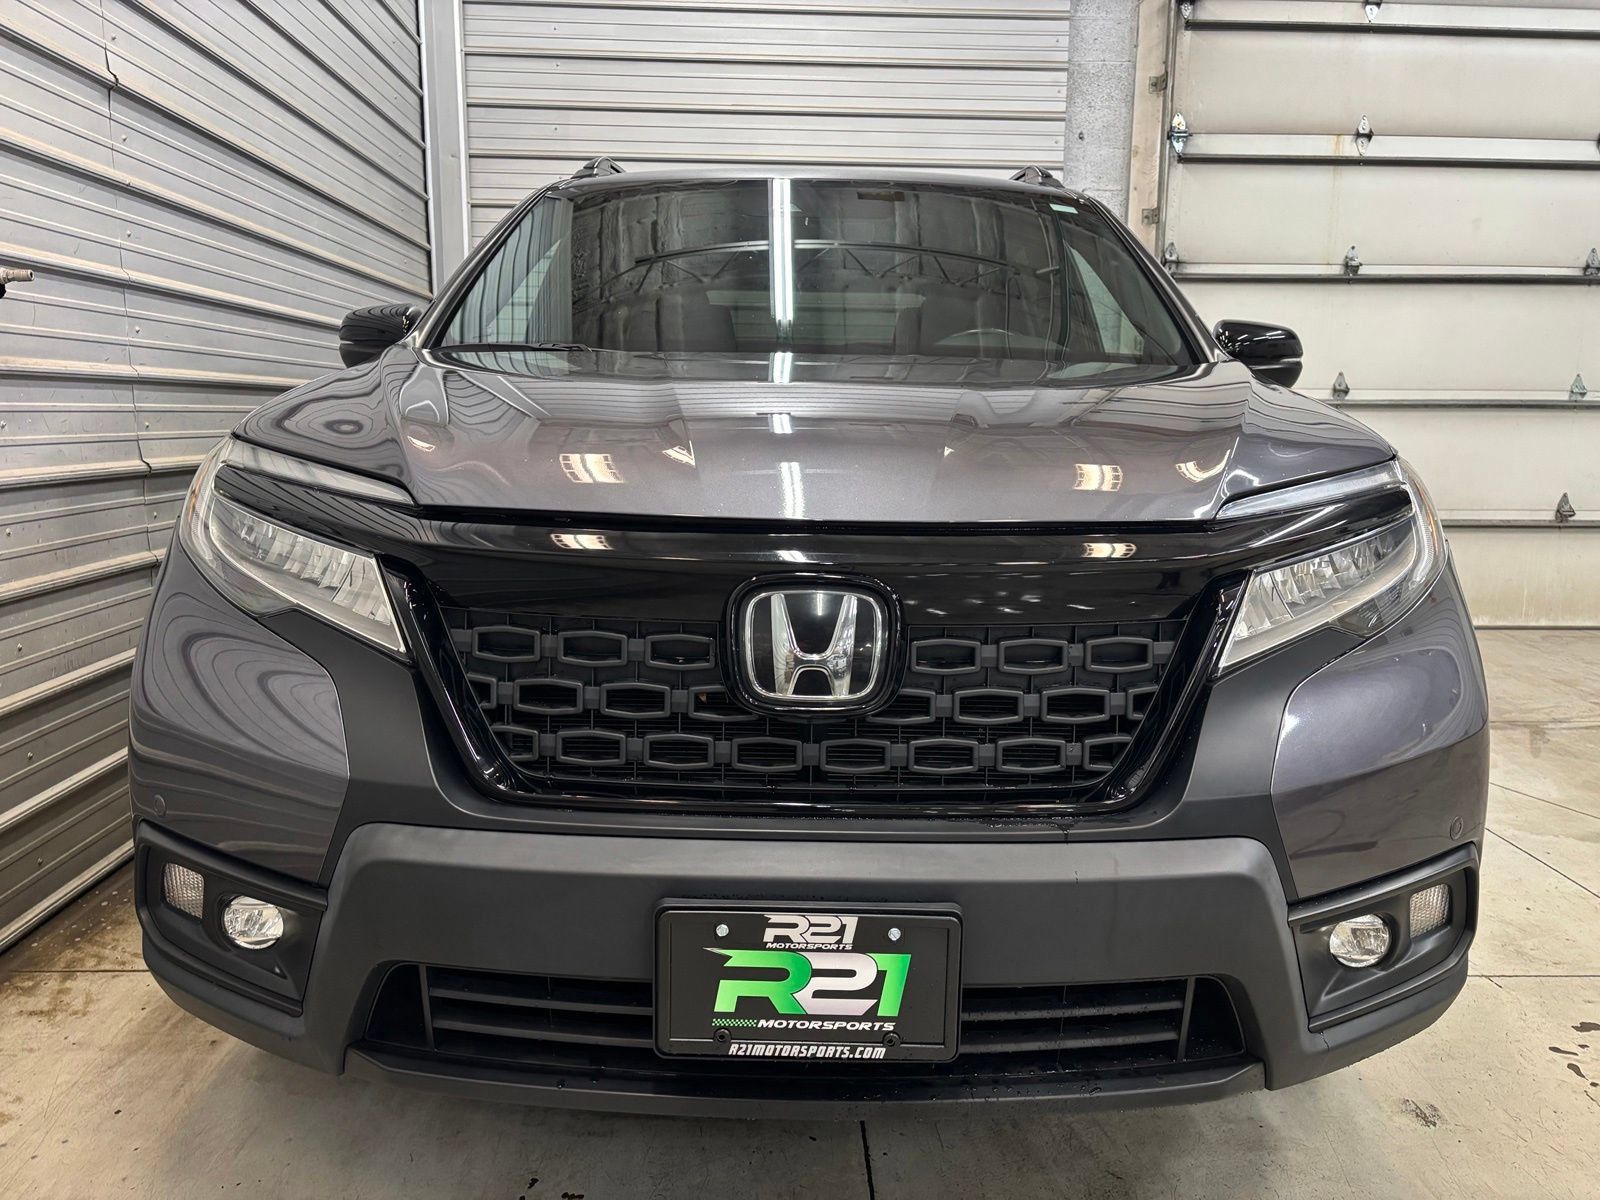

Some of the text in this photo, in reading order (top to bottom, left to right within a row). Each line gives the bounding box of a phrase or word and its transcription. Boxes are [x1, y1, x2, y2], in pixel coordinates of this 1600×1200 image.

[763, 914, 859, 943] R21
[765, 942, 853, 950] MOTORSPORTS
[703, 947, 912, 1016] R21
[757, 1019, 896, 1031] MOTORSPORTS
[728, 1044, 886, 1059] R21MOTORSPORTS.COM
